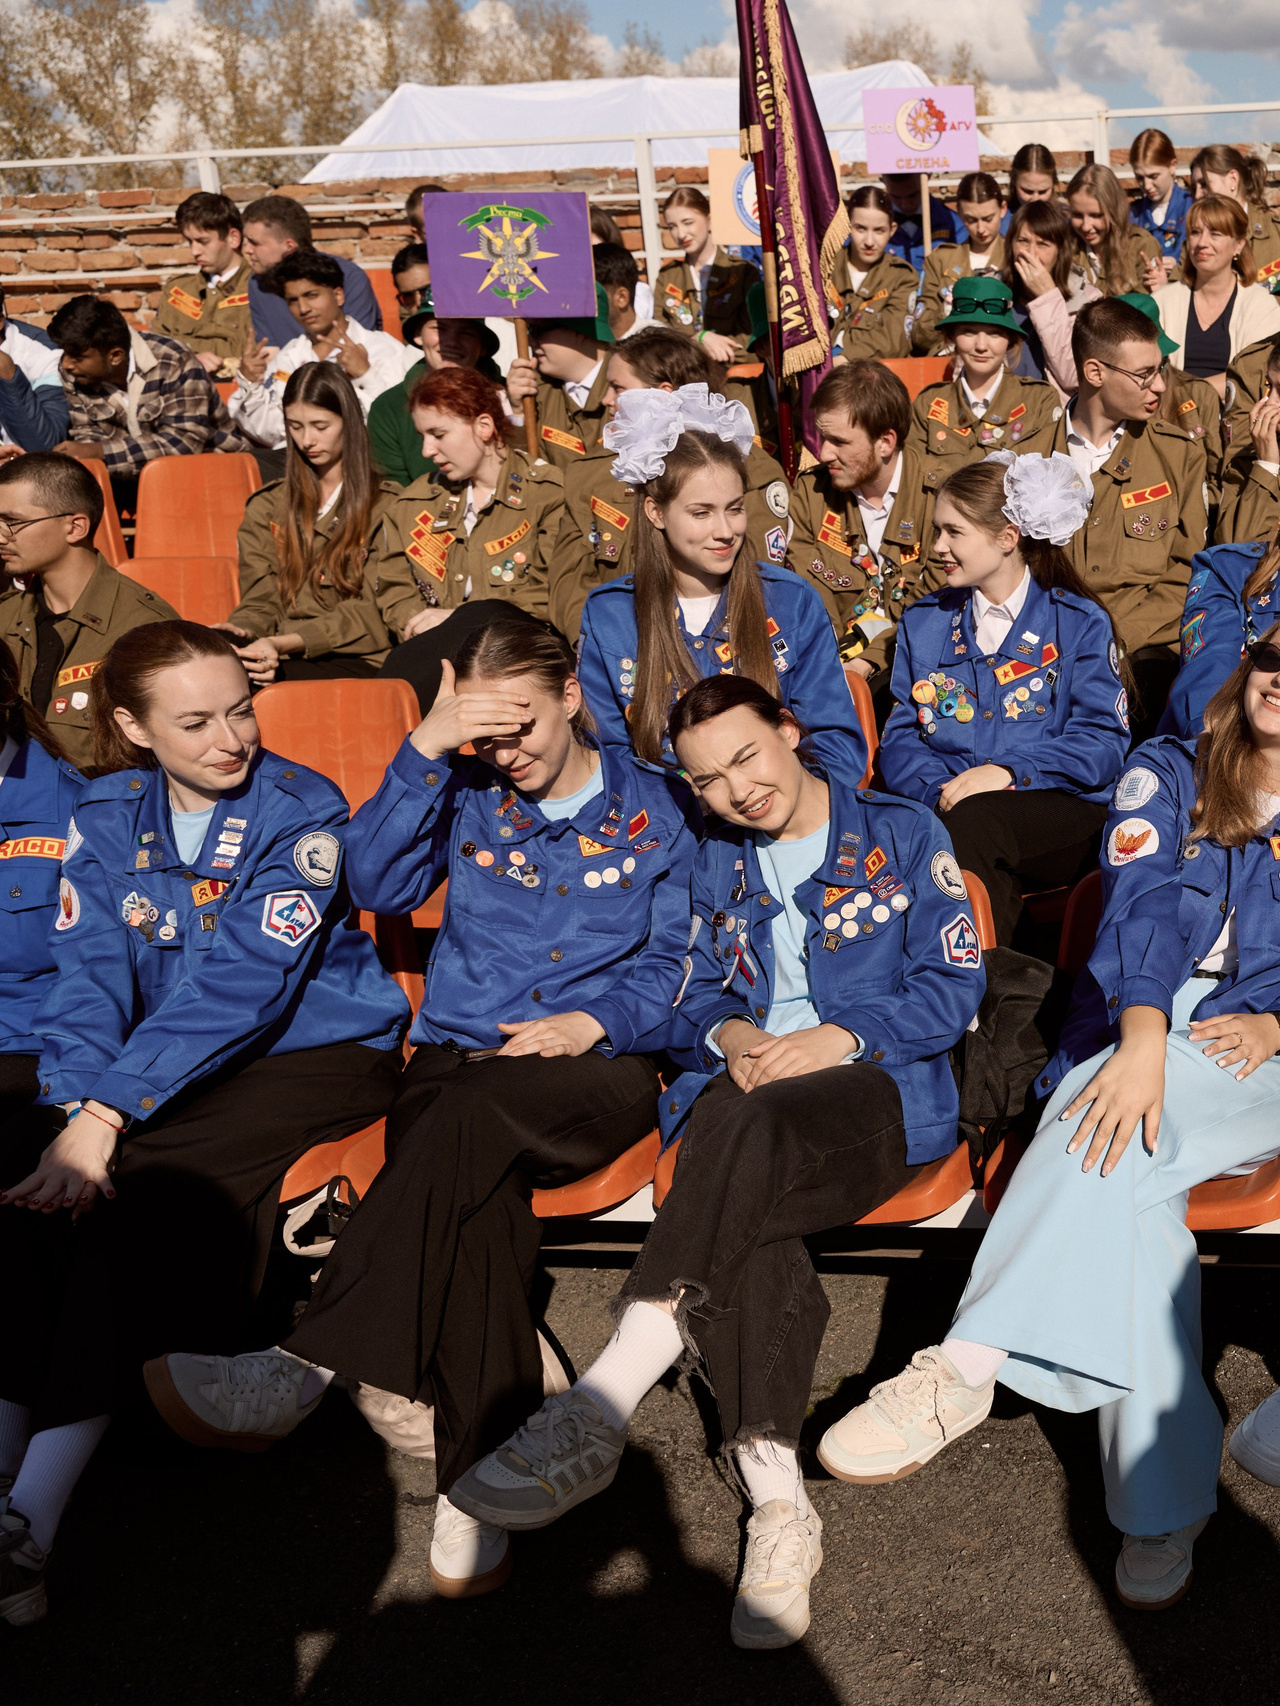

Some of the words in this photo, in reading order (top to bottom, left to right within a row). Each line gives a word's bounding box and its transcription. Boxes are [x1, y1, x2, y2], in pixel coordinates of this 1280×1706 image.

[868, 123, 893, 134] СПО
[949, 121, 972, 131] АГУ
[895, 157, 950, 169] СЕЛЕНА
